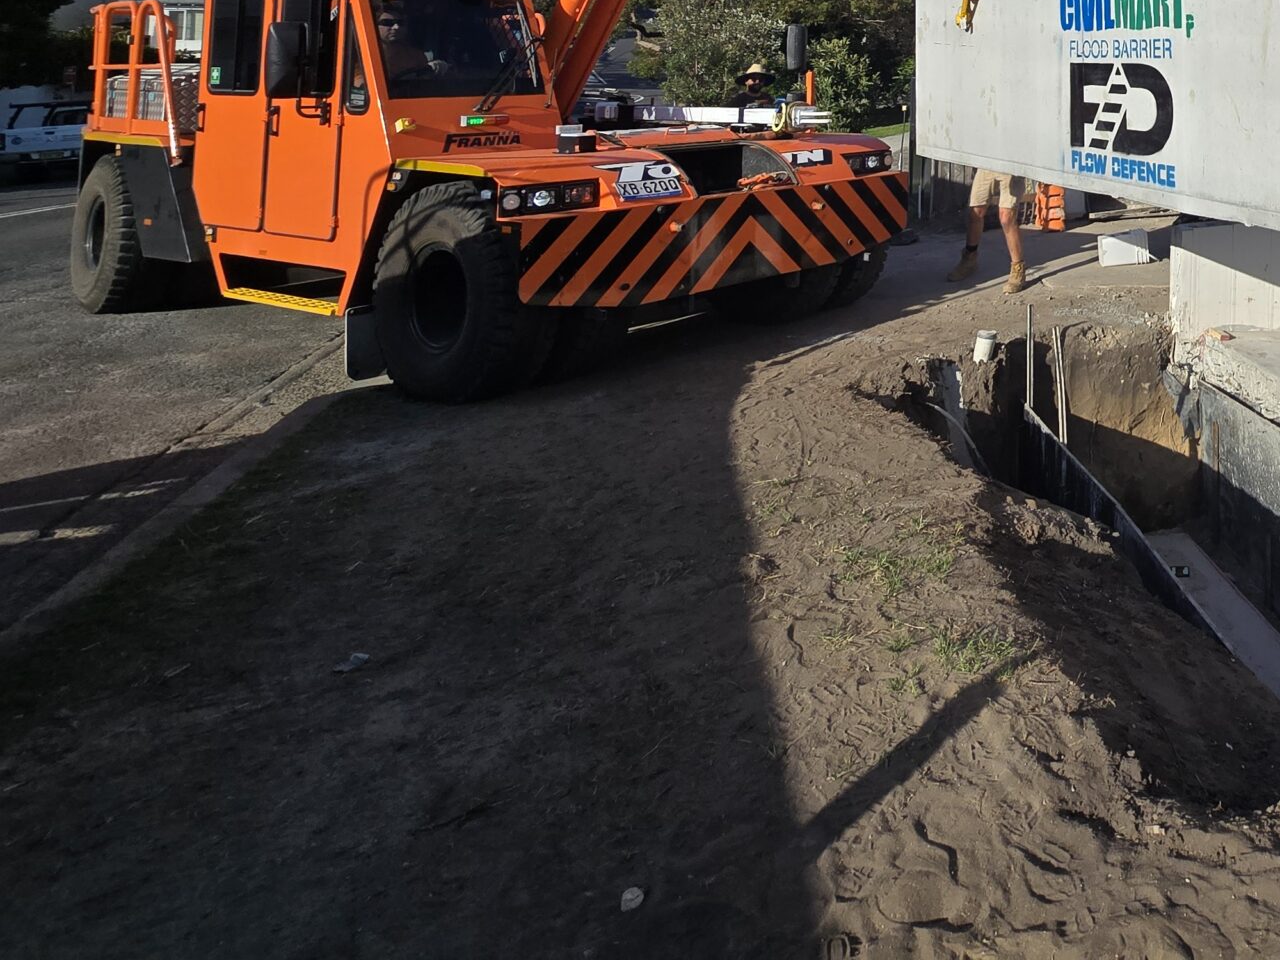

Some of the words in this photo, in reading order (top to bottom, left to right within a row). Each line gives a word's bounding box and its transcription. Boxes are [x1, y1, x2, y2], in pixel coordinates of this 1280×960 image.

[1069, 39, 1109, 59] FLOOD
[1113, 38, 1173, 59] BARRIER
[442, 131, 521, 153] FRANNA
[1071, 150, 1108, 176] FLOW
[1111, 156, 1176, 188] DEFENCE
